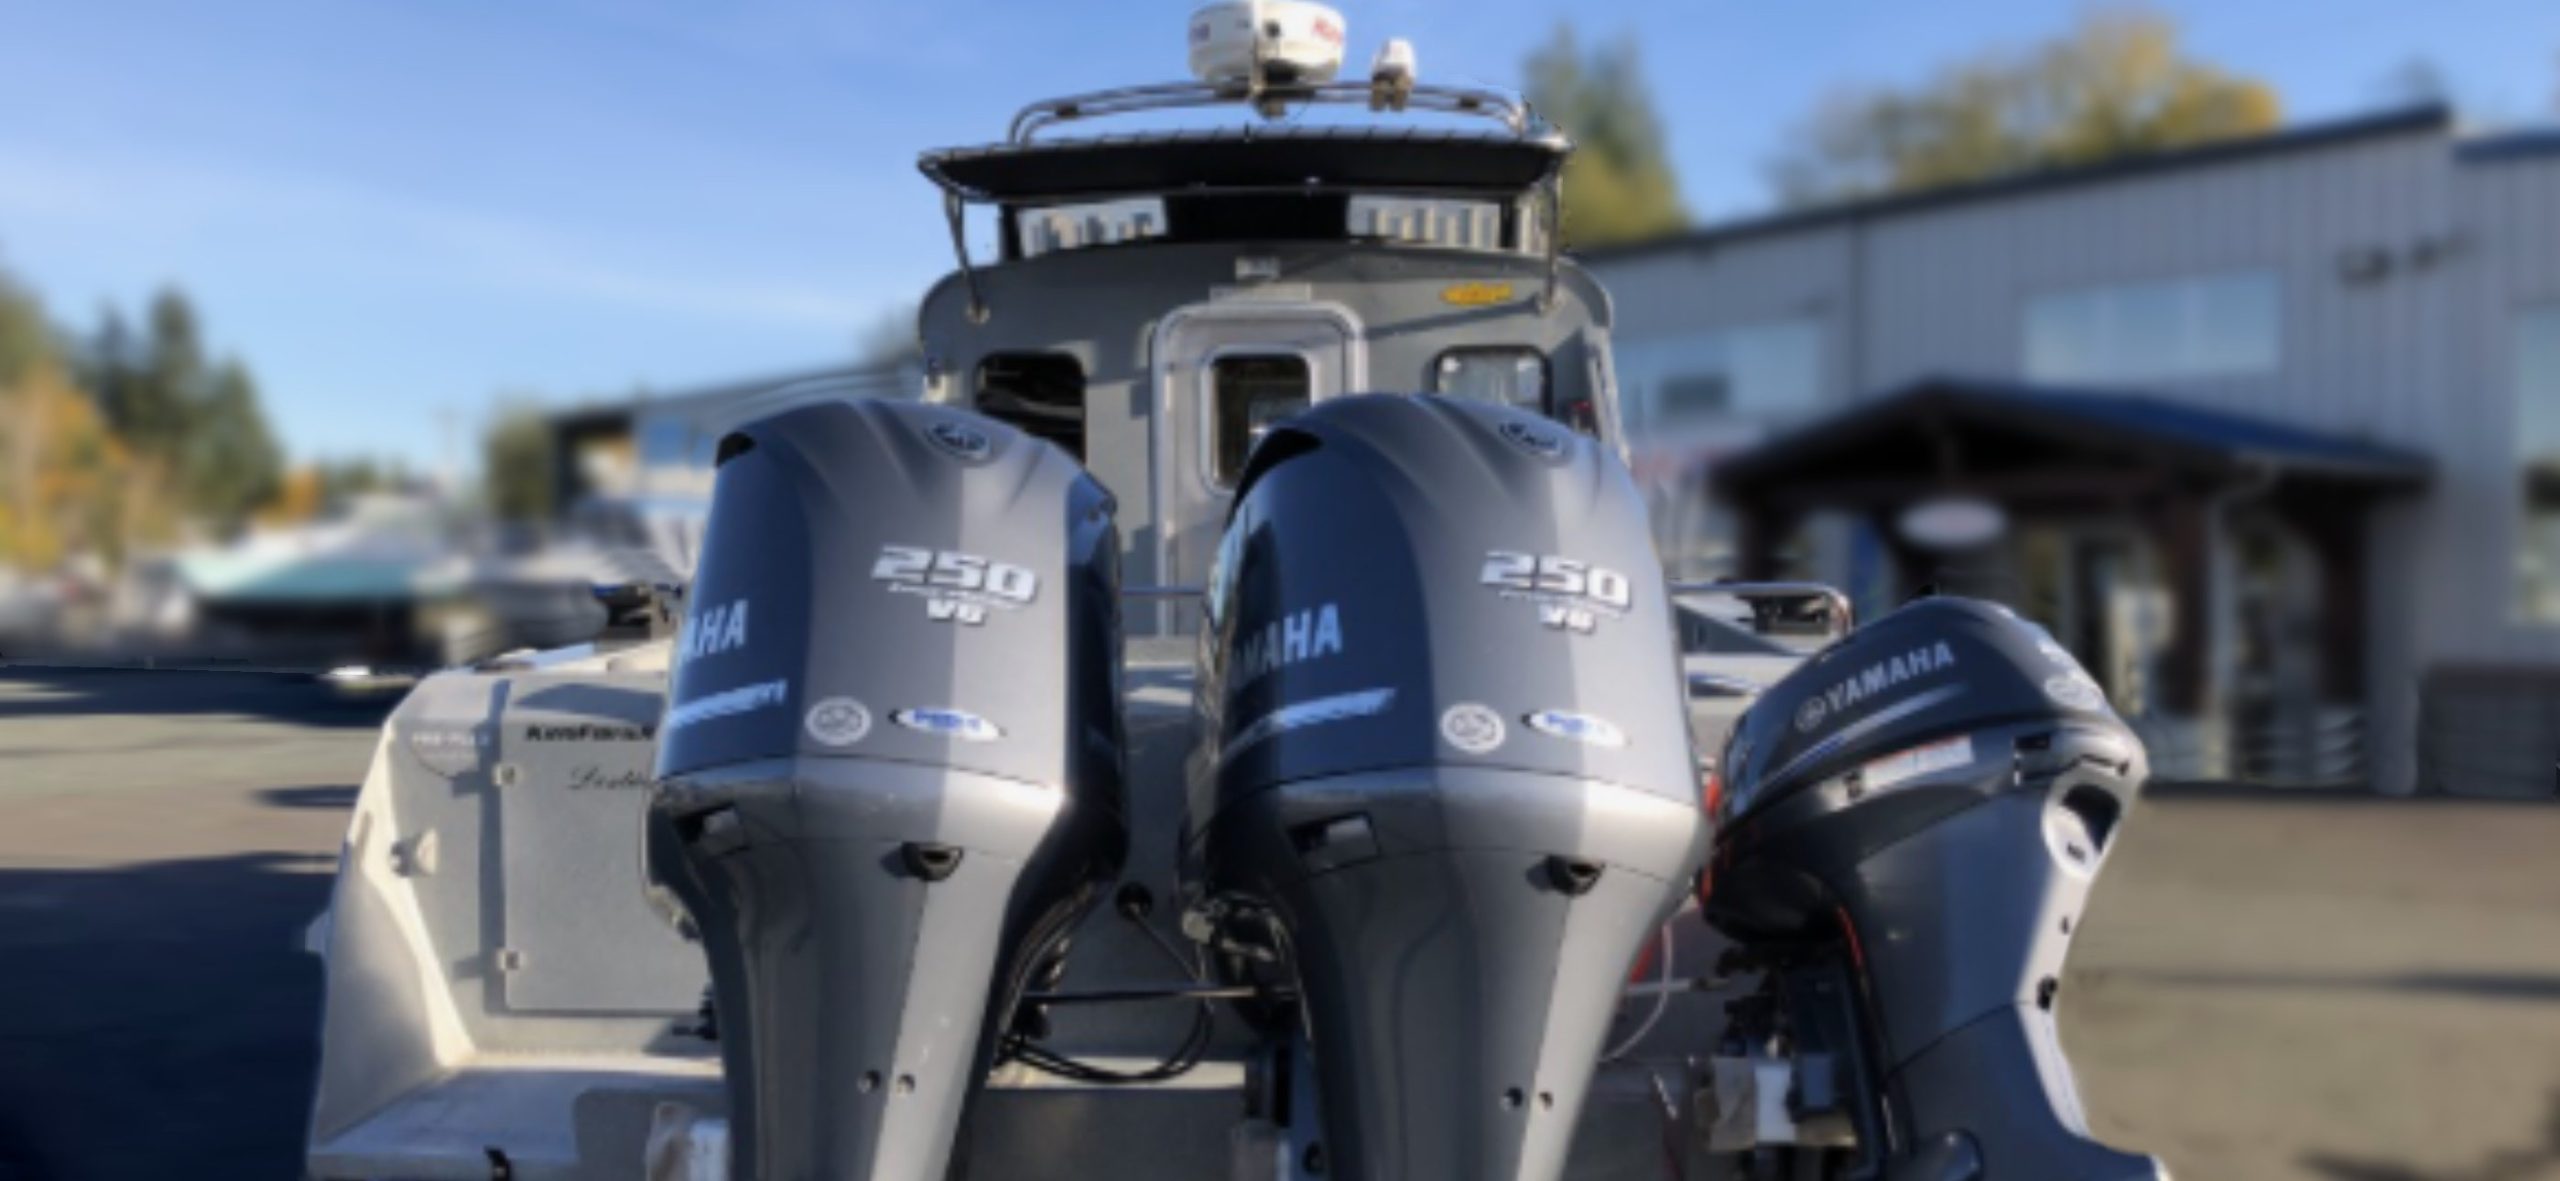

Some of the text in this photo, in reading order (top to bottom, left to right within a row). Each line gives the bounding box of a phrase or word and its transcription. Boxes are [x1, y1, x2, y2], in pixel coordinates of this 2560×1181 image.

[870, 543, 1037, 601] 250
[1480, 550, 1631, 608] 250
[1824, 640, 1954, 713] YAMAHA
